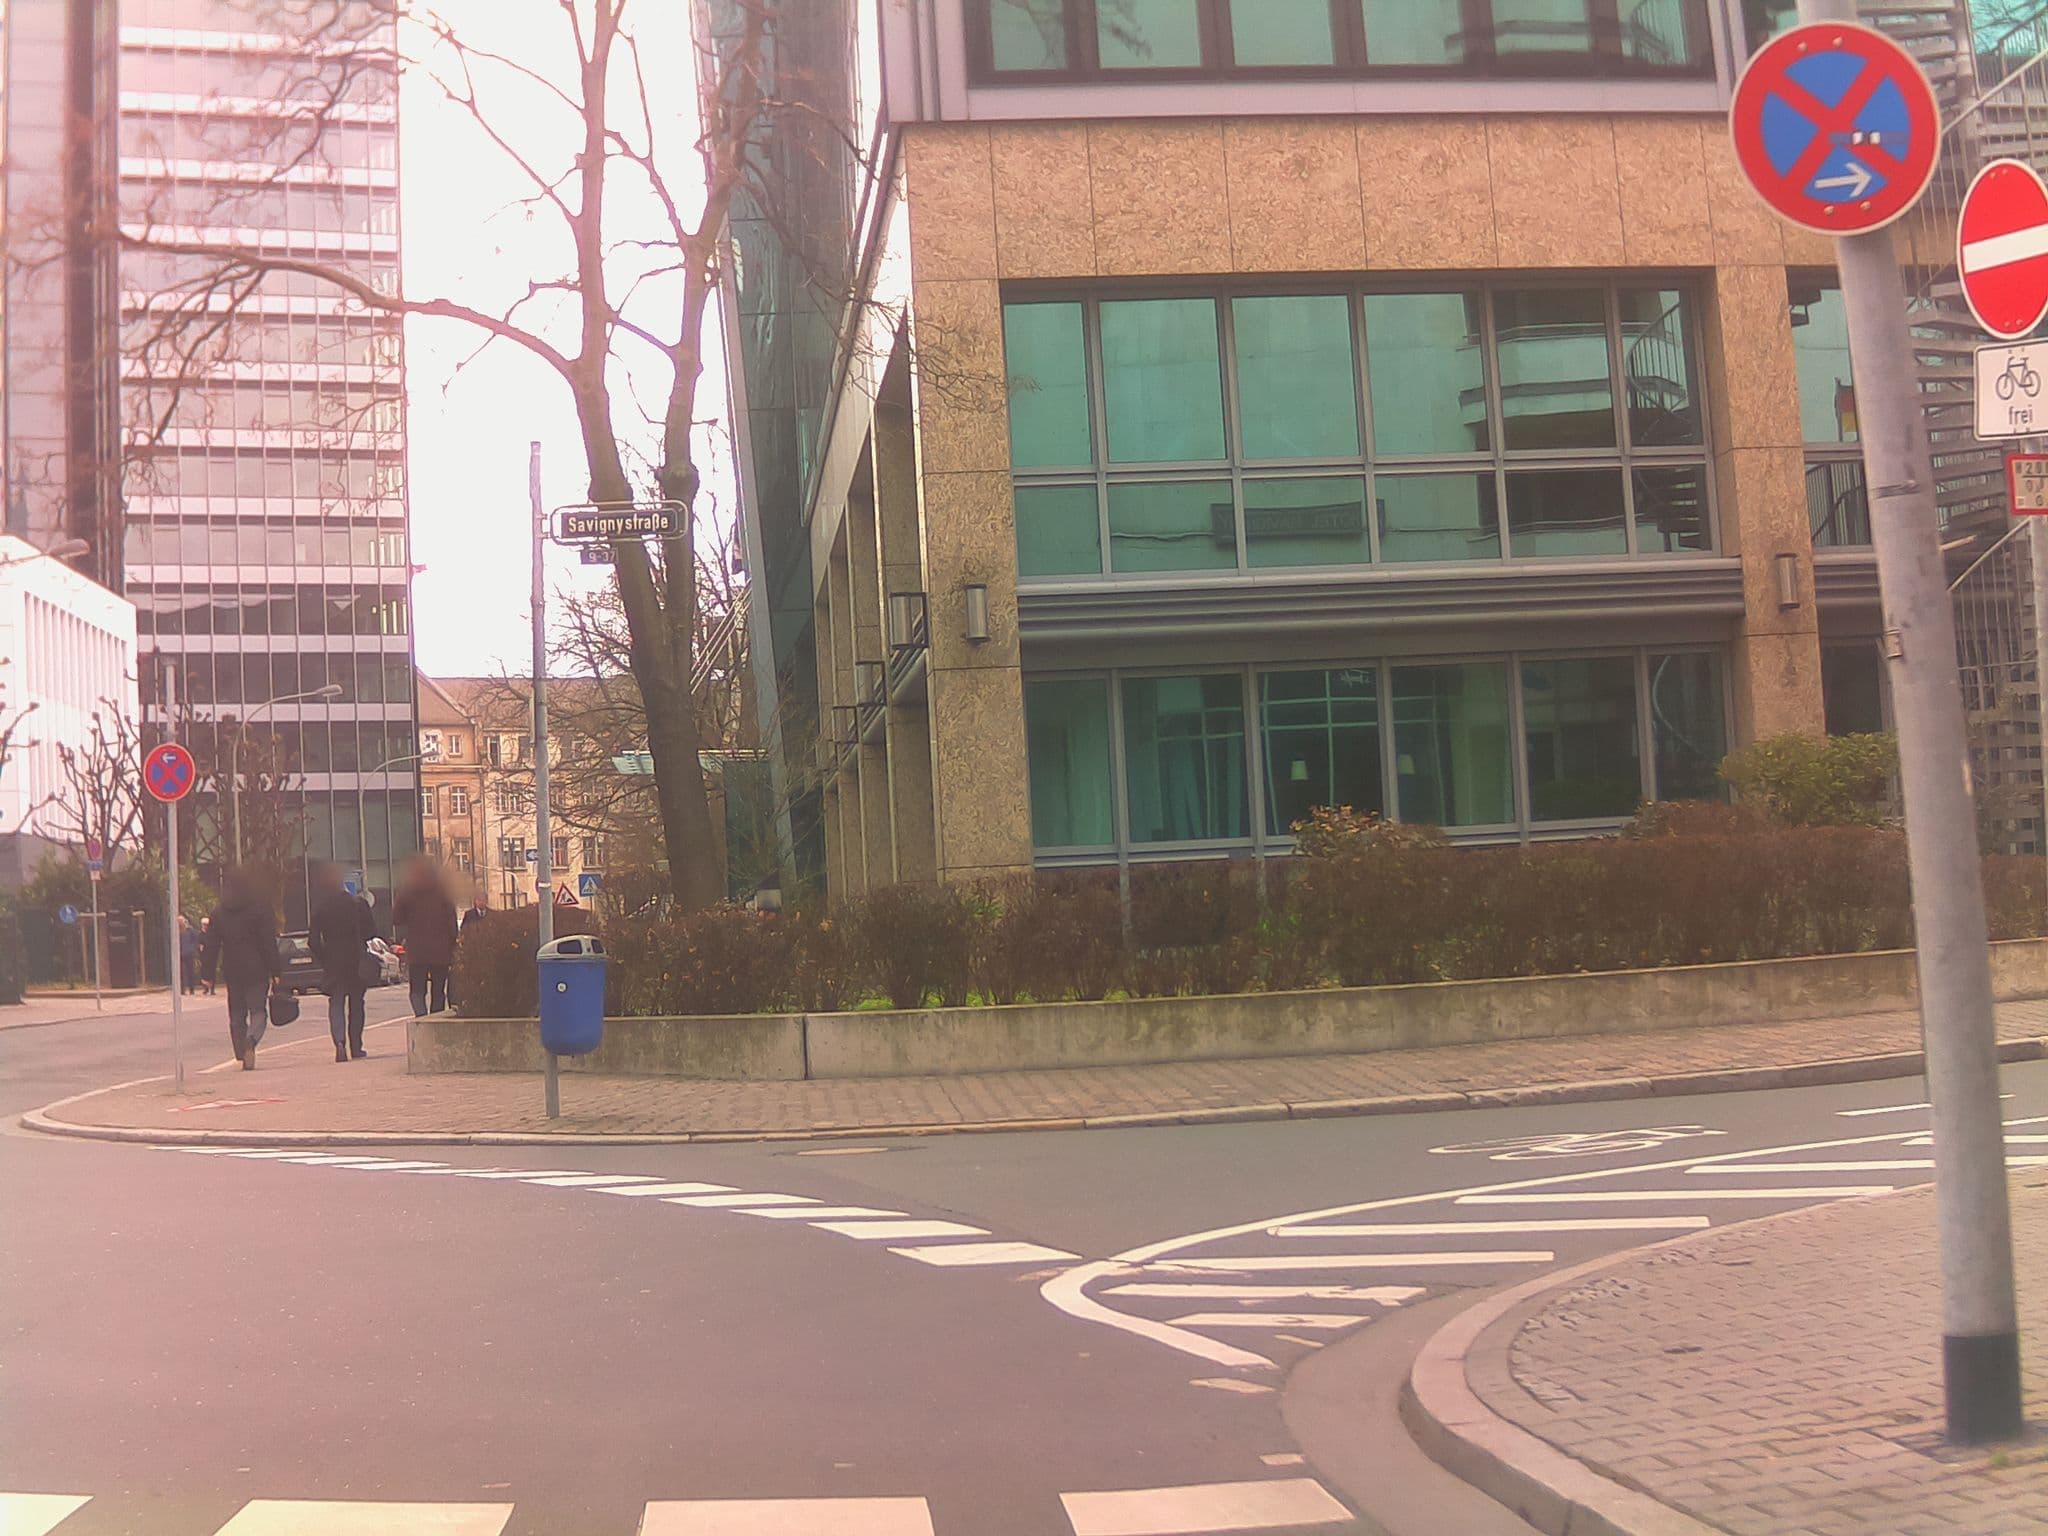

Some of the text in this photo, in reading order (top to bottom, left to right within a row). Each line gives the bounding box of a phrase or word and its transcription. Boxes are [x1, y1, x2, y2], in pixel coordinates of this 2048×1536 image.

[2008, 404, 2033, 424] frei
[568, 513, 669, 534] Savignystraße
[588, 551, 616, 562] 9-37
